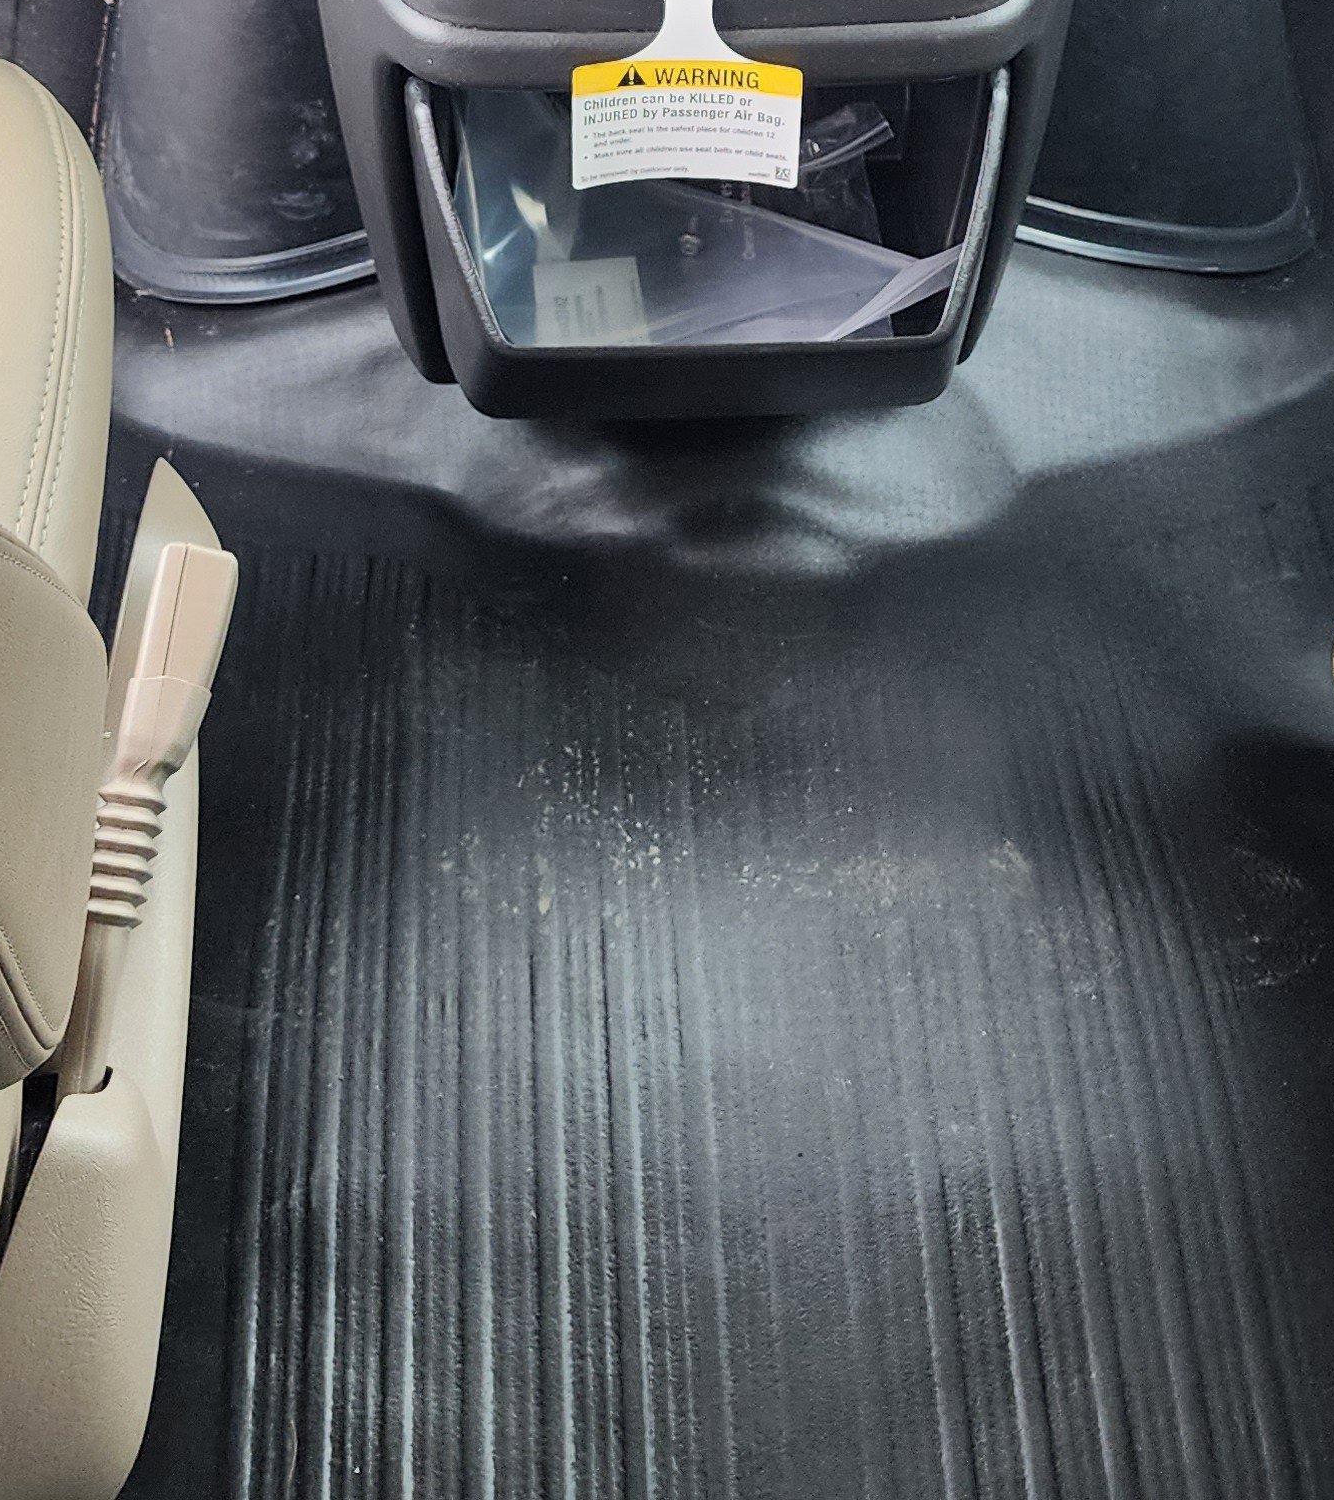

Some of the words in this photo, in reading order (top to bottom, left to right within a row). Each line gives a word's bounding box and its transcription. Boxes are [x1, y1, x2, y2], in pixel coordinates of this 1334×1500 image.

[655, 67, 760, 89] WARNING
[584, 95, 637, 111] Children
[641, 92, 665, 105] can
[669, 93, 685, 103] be
[689, 93, 735, 105] KILLED
[739, 97, 753, 107] or
[584, 108, 638, 126] INJURED
[643, 108, 658, 120] by
[662, 107, 729, 120] Passenger
[734, 109, 753, 121] Air
[757, 111, 786, 127] Bag.
